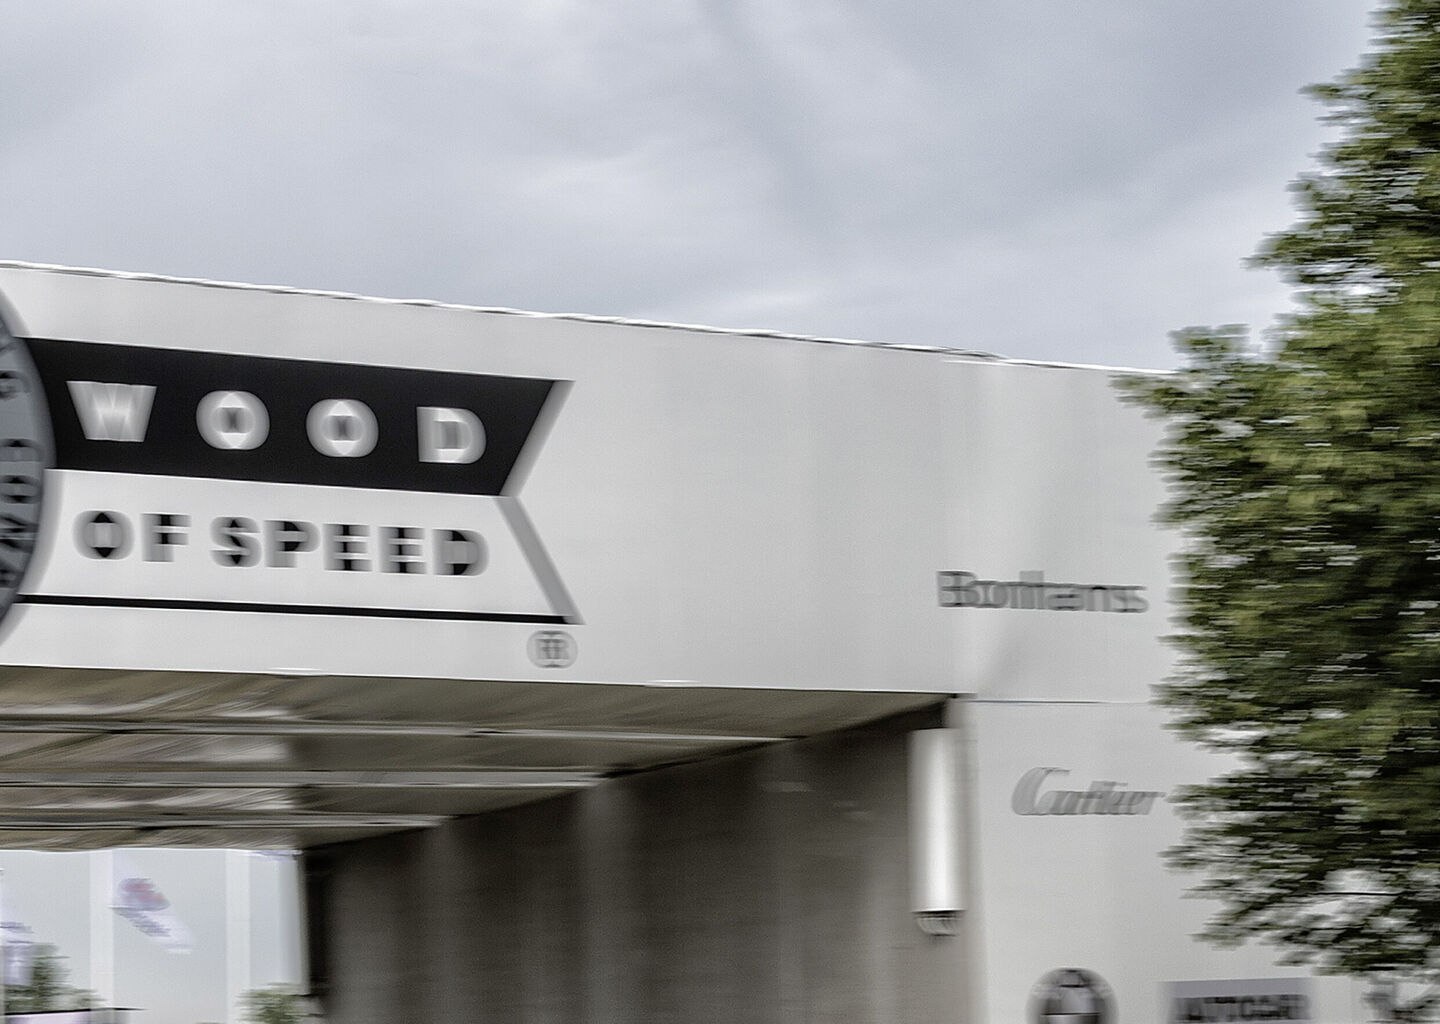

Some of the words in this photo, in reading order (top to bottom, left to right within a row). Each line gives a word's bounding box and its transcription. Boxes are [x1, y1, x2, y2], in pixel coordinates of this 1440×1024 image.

[65, 380, 487, 465] WOOD
[72, 509, 191, 563] OF
[209, 516, 490, 577] SPEED
